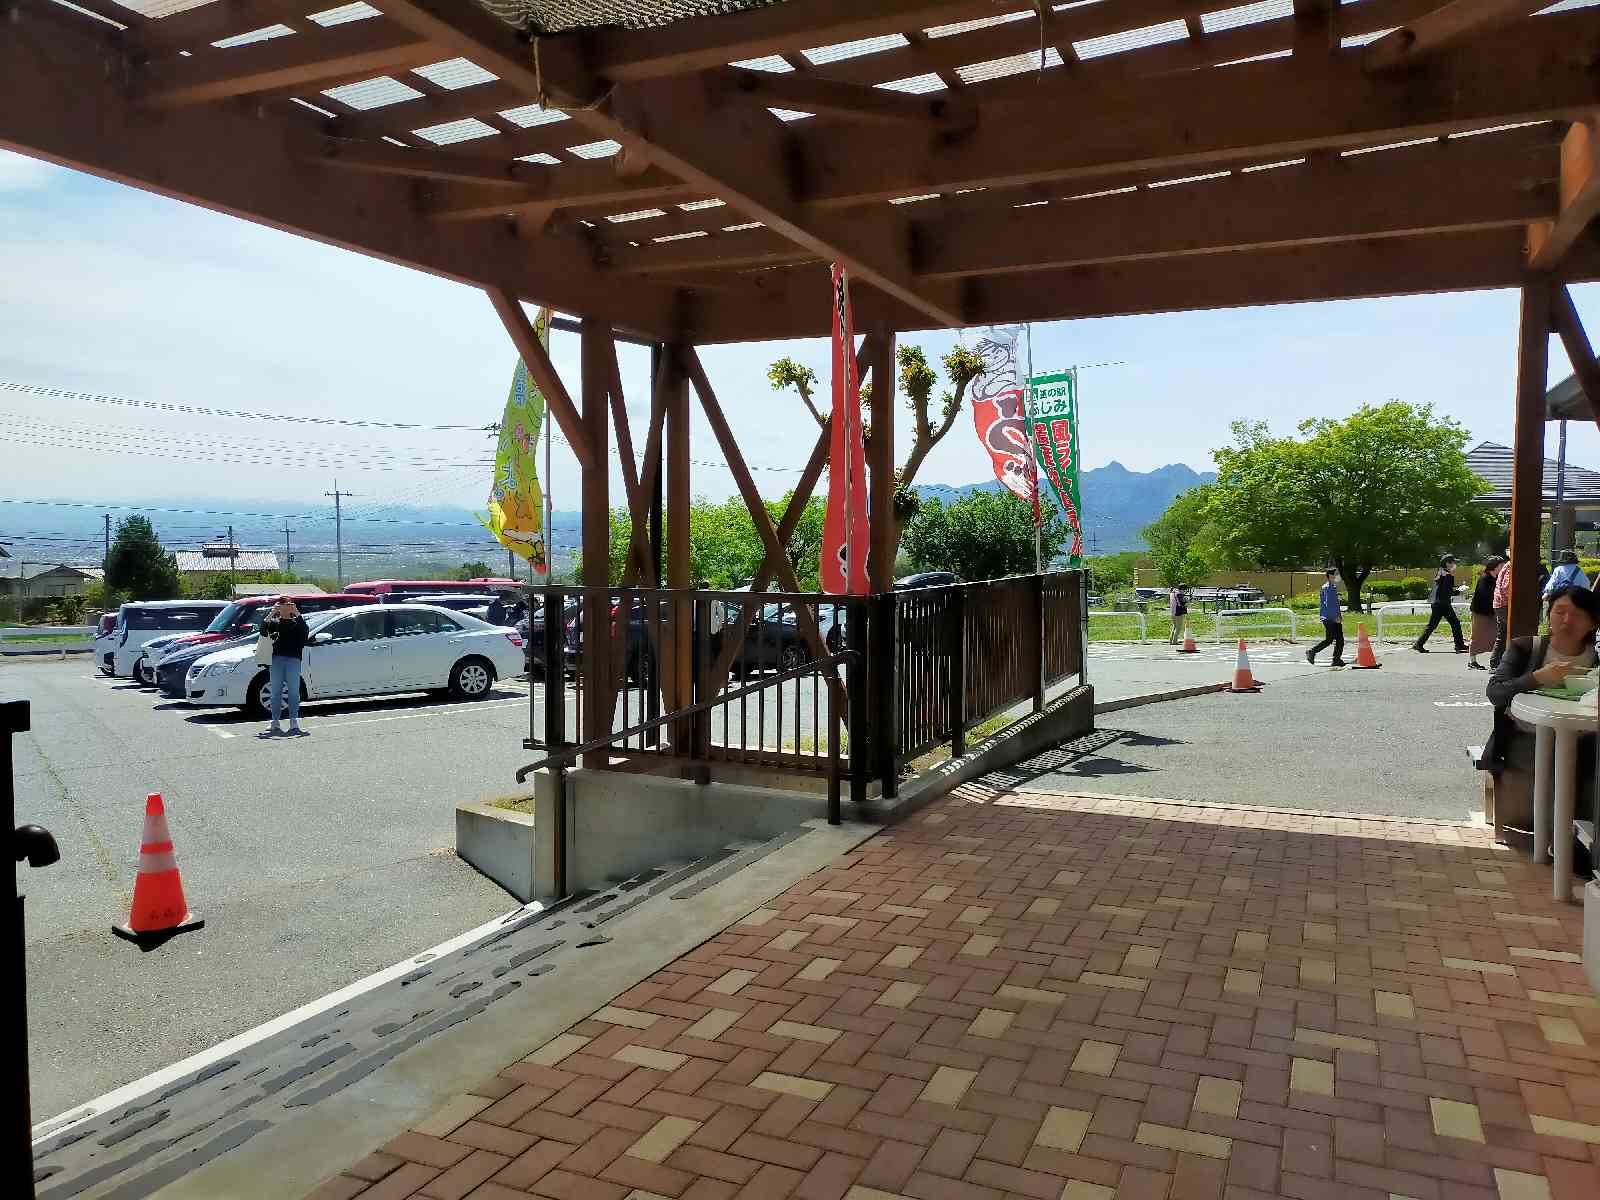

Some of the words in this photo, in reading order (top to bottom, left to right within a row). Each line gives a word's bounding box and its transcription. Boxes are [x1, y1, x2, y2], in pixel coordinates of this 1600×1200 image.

[1040, 387, 1066, 399] 道の駅
[1031, 399, 1067, 416] ふじみ
